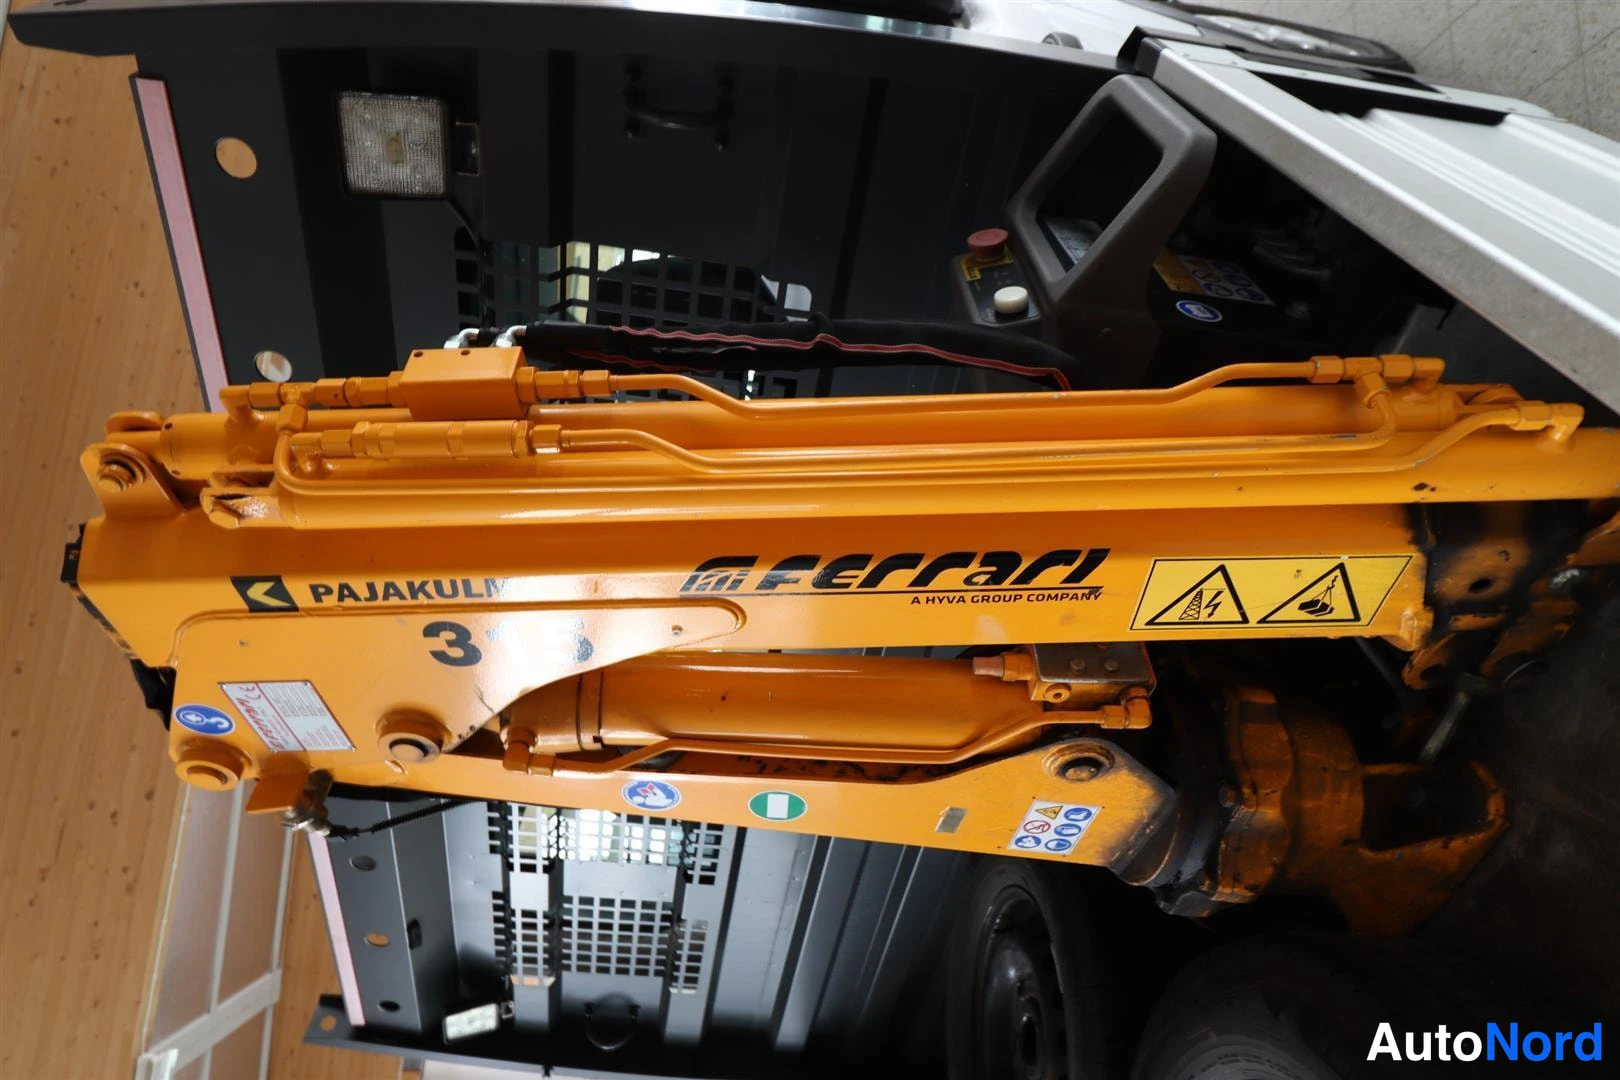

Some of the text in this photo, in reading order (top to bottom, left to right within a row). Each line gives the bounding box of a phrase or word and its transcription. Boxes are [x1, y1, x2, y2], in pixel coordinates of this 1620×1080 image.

[756, 548, 1111, 590] Ferrari
[309, 577, 543, 603] PAJAKULM
[911, 591, 1102, 605] A HYVA GROUP COMPANY
